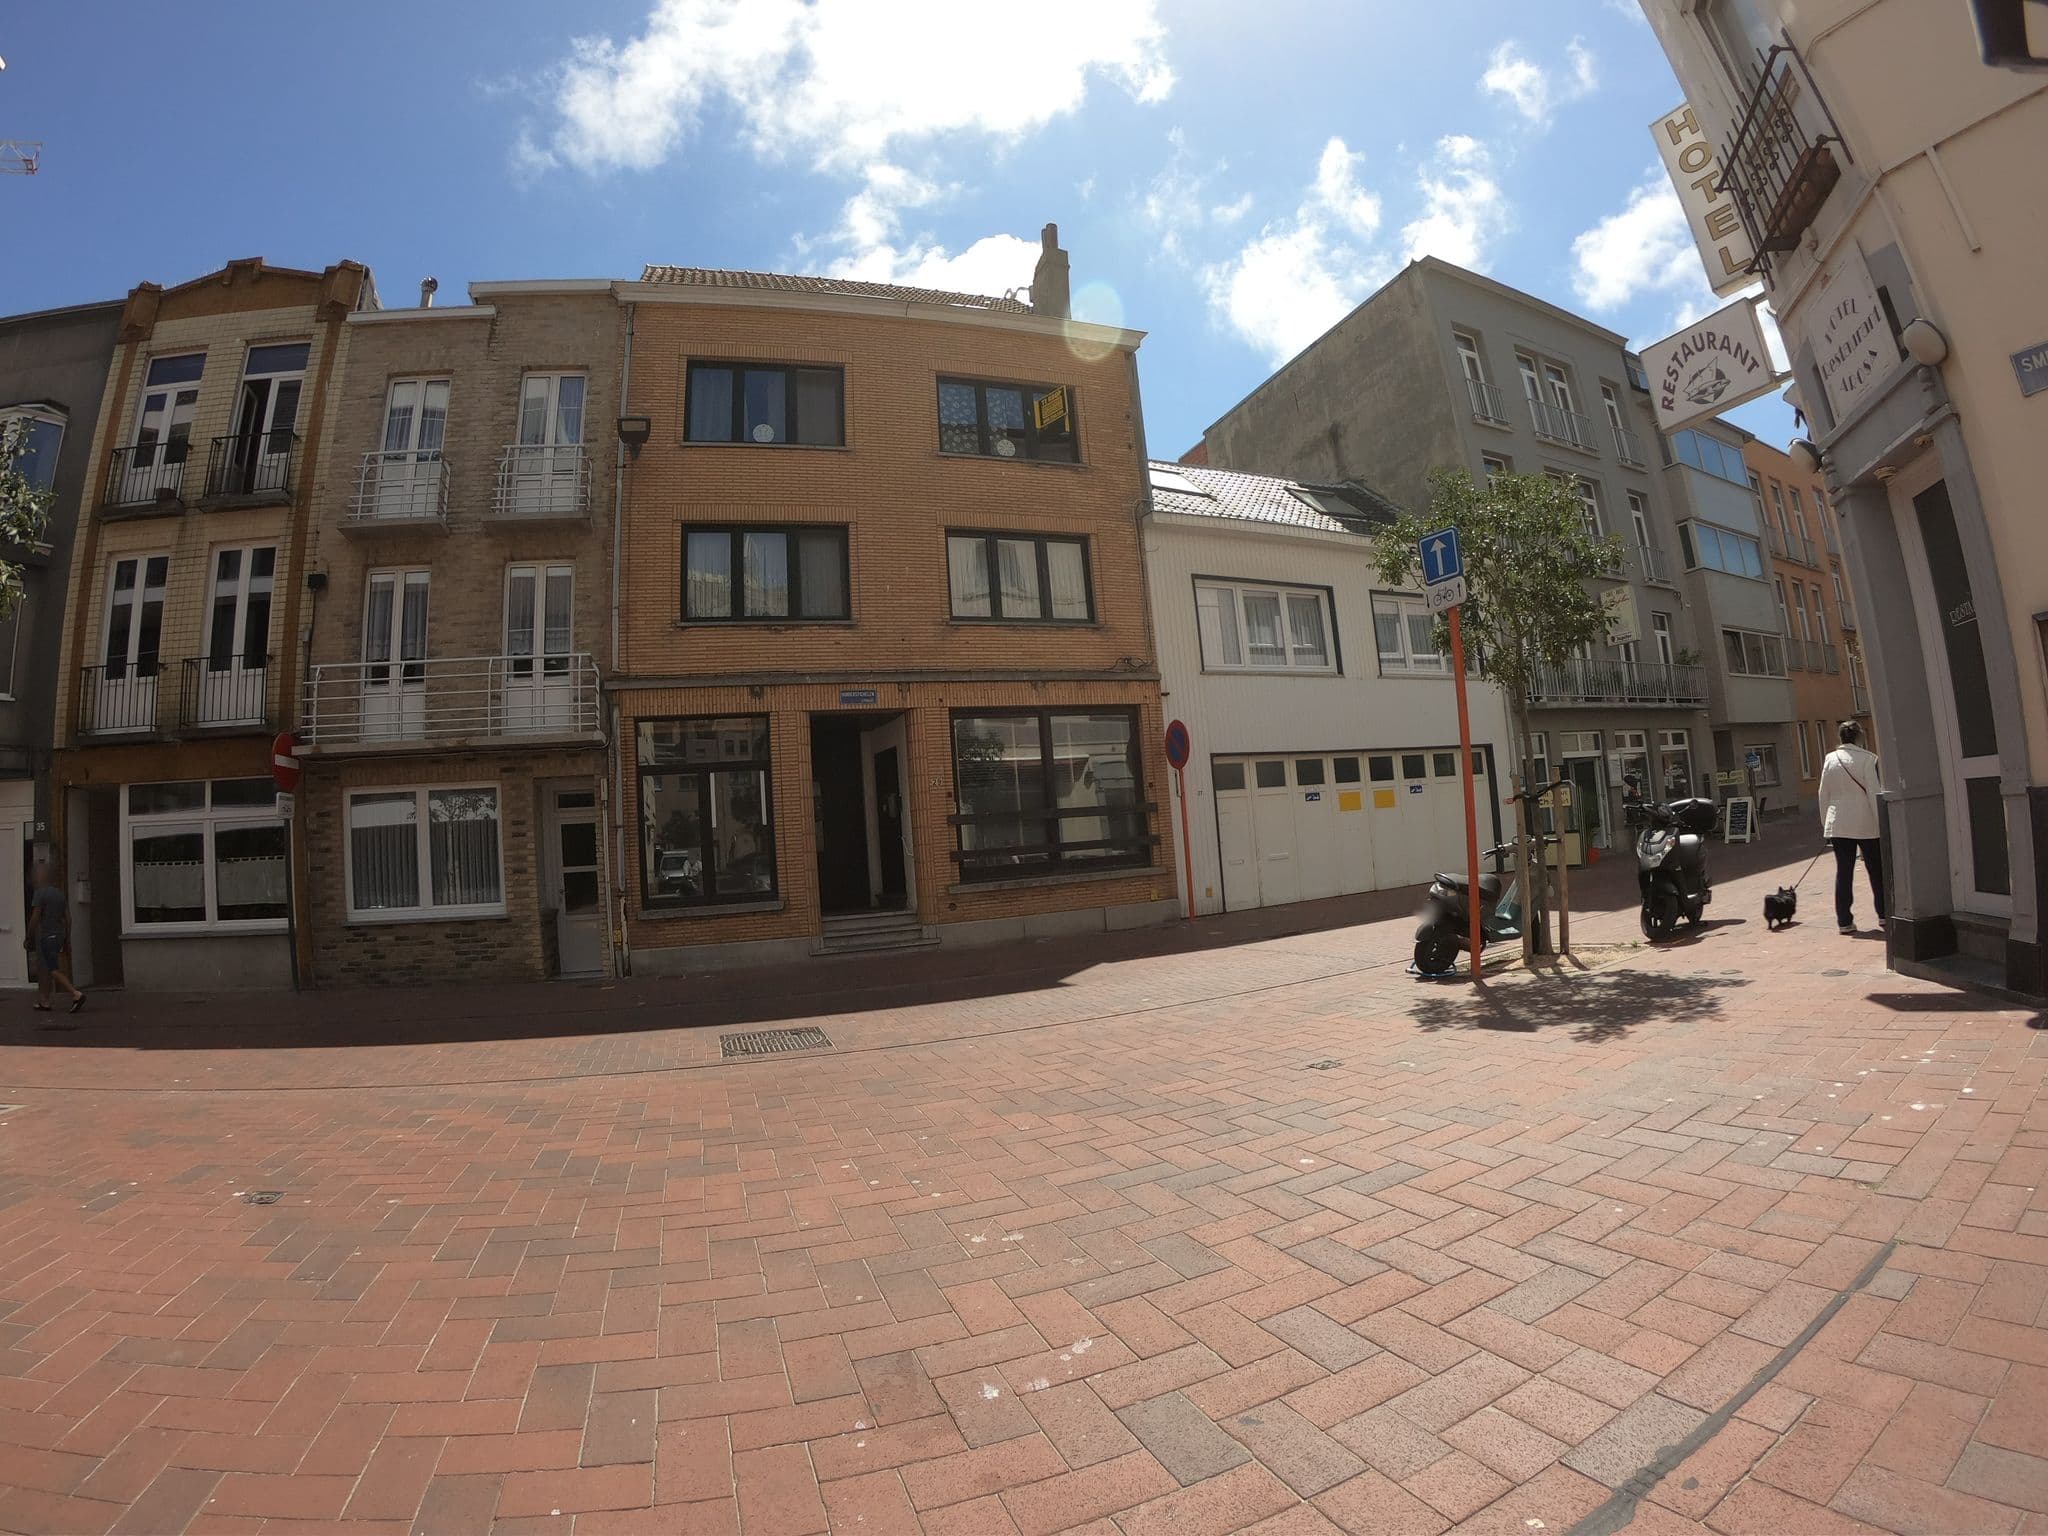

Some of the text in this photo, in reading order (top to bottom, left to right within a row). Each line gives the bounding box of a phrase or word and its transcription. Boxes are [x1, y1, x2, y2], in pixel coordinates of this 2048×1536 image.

[1665, 107, 1752, 276] HOTEL
[1661, 330, 1760, 412] RESTAURANT
[2021, 350, 2048, 373] SM
[35, 821, 46, 831] 35
